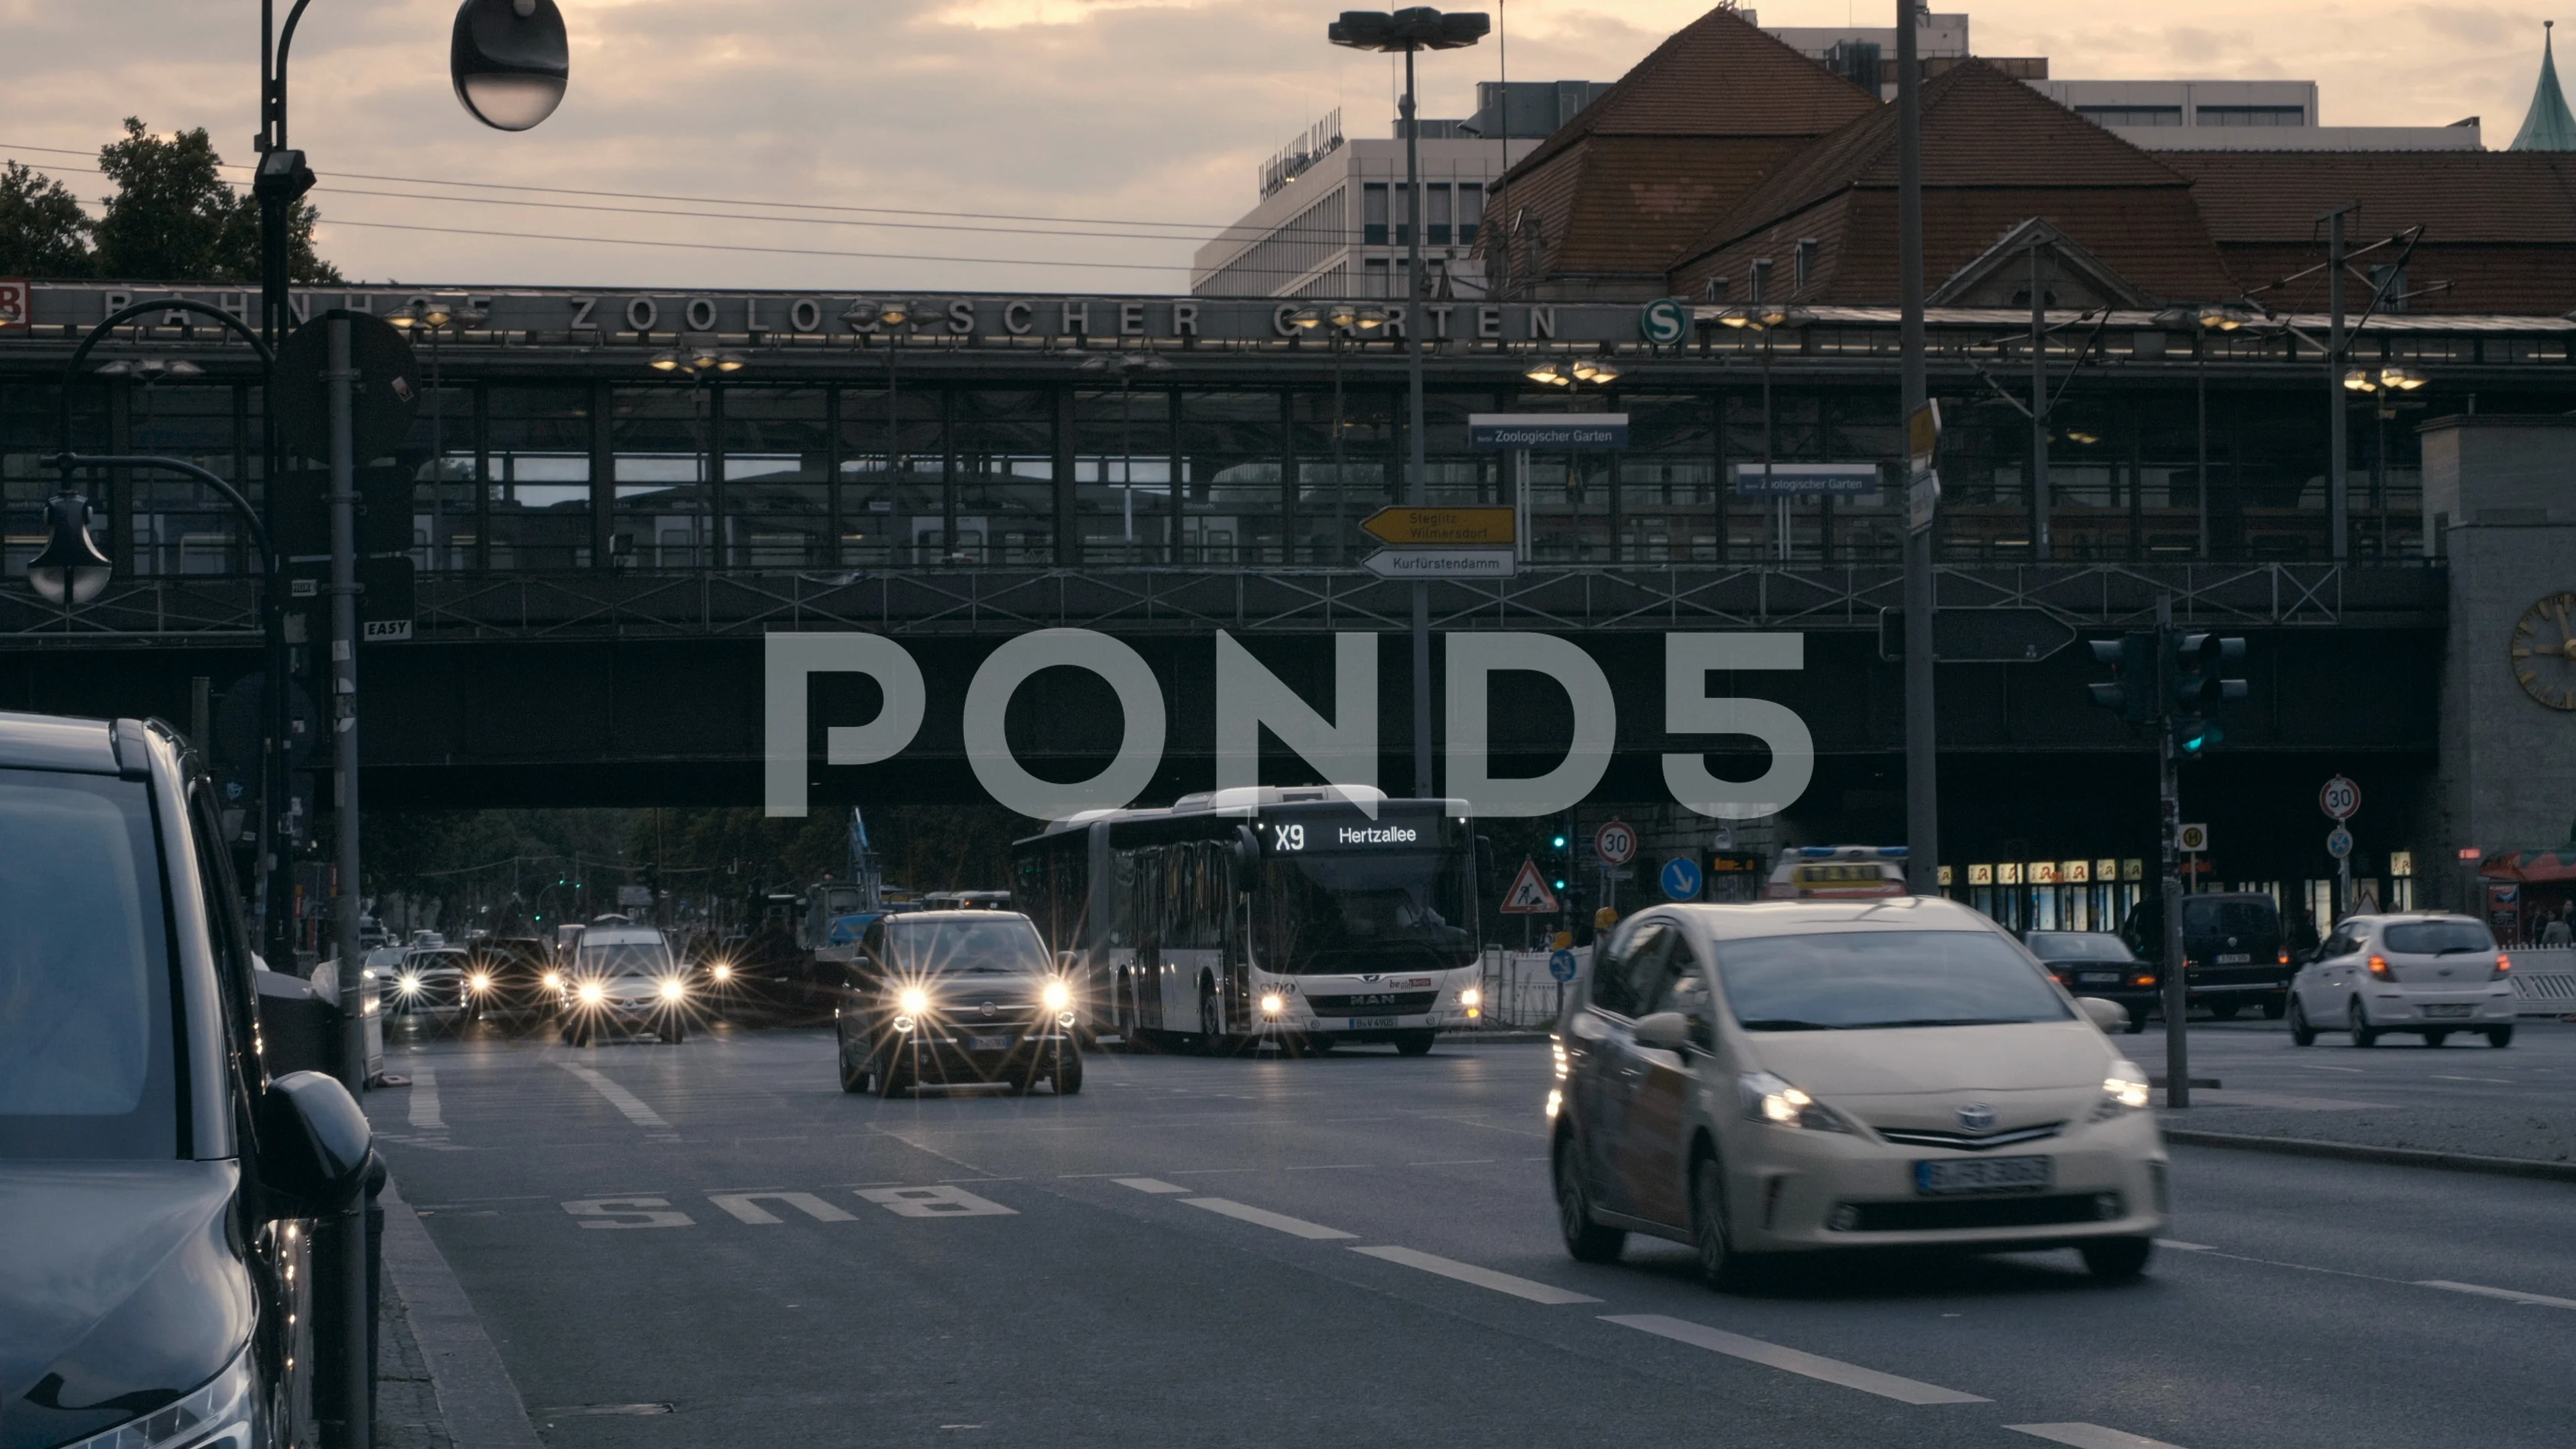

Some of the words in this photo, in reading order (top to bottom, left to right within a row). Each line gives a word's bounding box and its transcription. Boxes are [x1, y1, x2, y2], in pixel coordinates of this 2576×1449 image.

[1273, 303, 1555, 338] GRTEN
[1650, 303, 1680, 339] S
[1495, 430, 1570, 445] Zoologischer
[1574, 430, 1613, 442] Garten
[1760, 479, 1826, 491] Zologischer
[1828, 479, 1862, 489] Garten
[1409, 513, 1457, 526] Steglitz
[1410, 527, 1488, 539] Wilmersdorf
[1393, 556, 1500, 570] Kurfürstendamm
[368, 621, 407, 635] EASY
[2328, 789, 2352, 808] 30
[1275, 824, 1304, 851] X9
[1339, 826, 1417, 844] Hertzallee
[1605, 833, 1627, 853] 30
[1350, 995, 1395, 1006] MAN
[560, 1185, 1020, 1229] BUS
